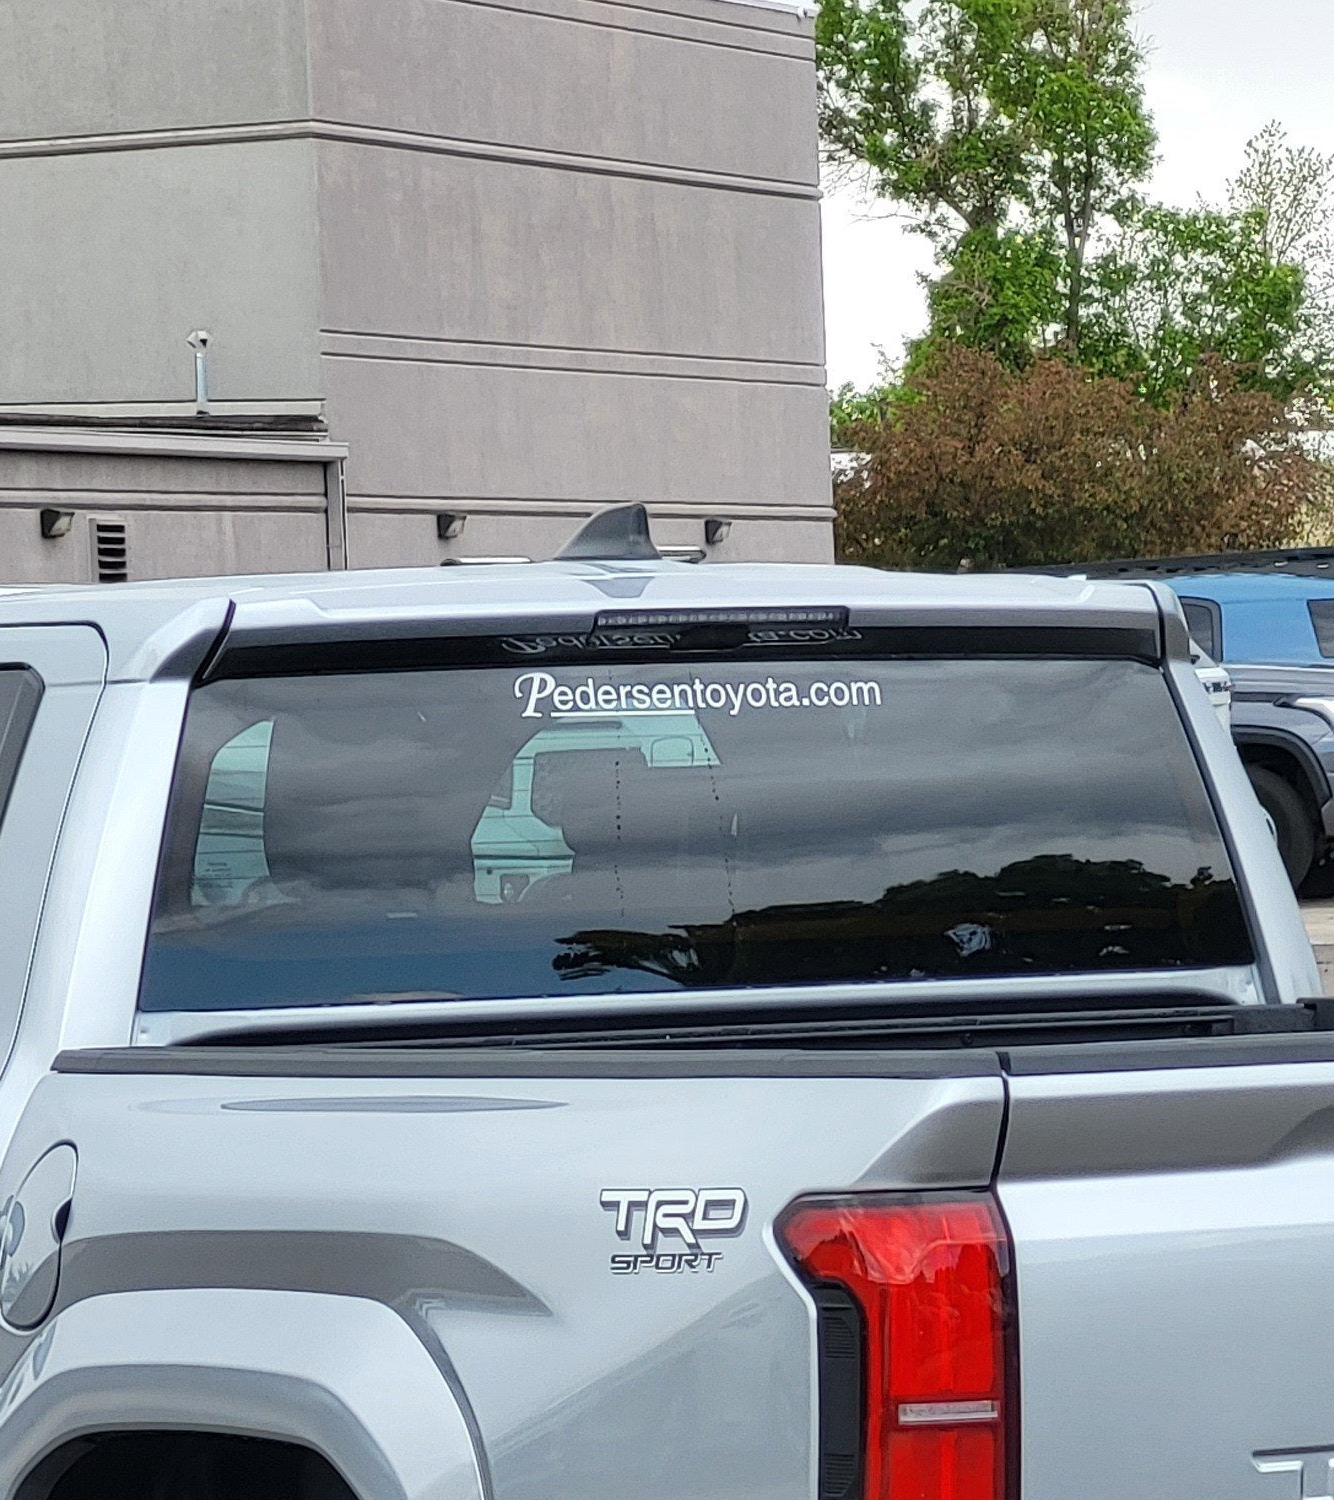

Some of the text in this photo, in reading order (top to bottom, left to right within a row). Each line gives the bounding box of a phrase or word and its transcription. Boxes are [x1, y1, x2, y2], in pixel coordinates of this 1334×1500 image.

[514, 672, 882, 719] Pedersentoyota.com
[599, 1187, 749, 1254] TRD
[610, 1252, 723, 1275] SPORT
